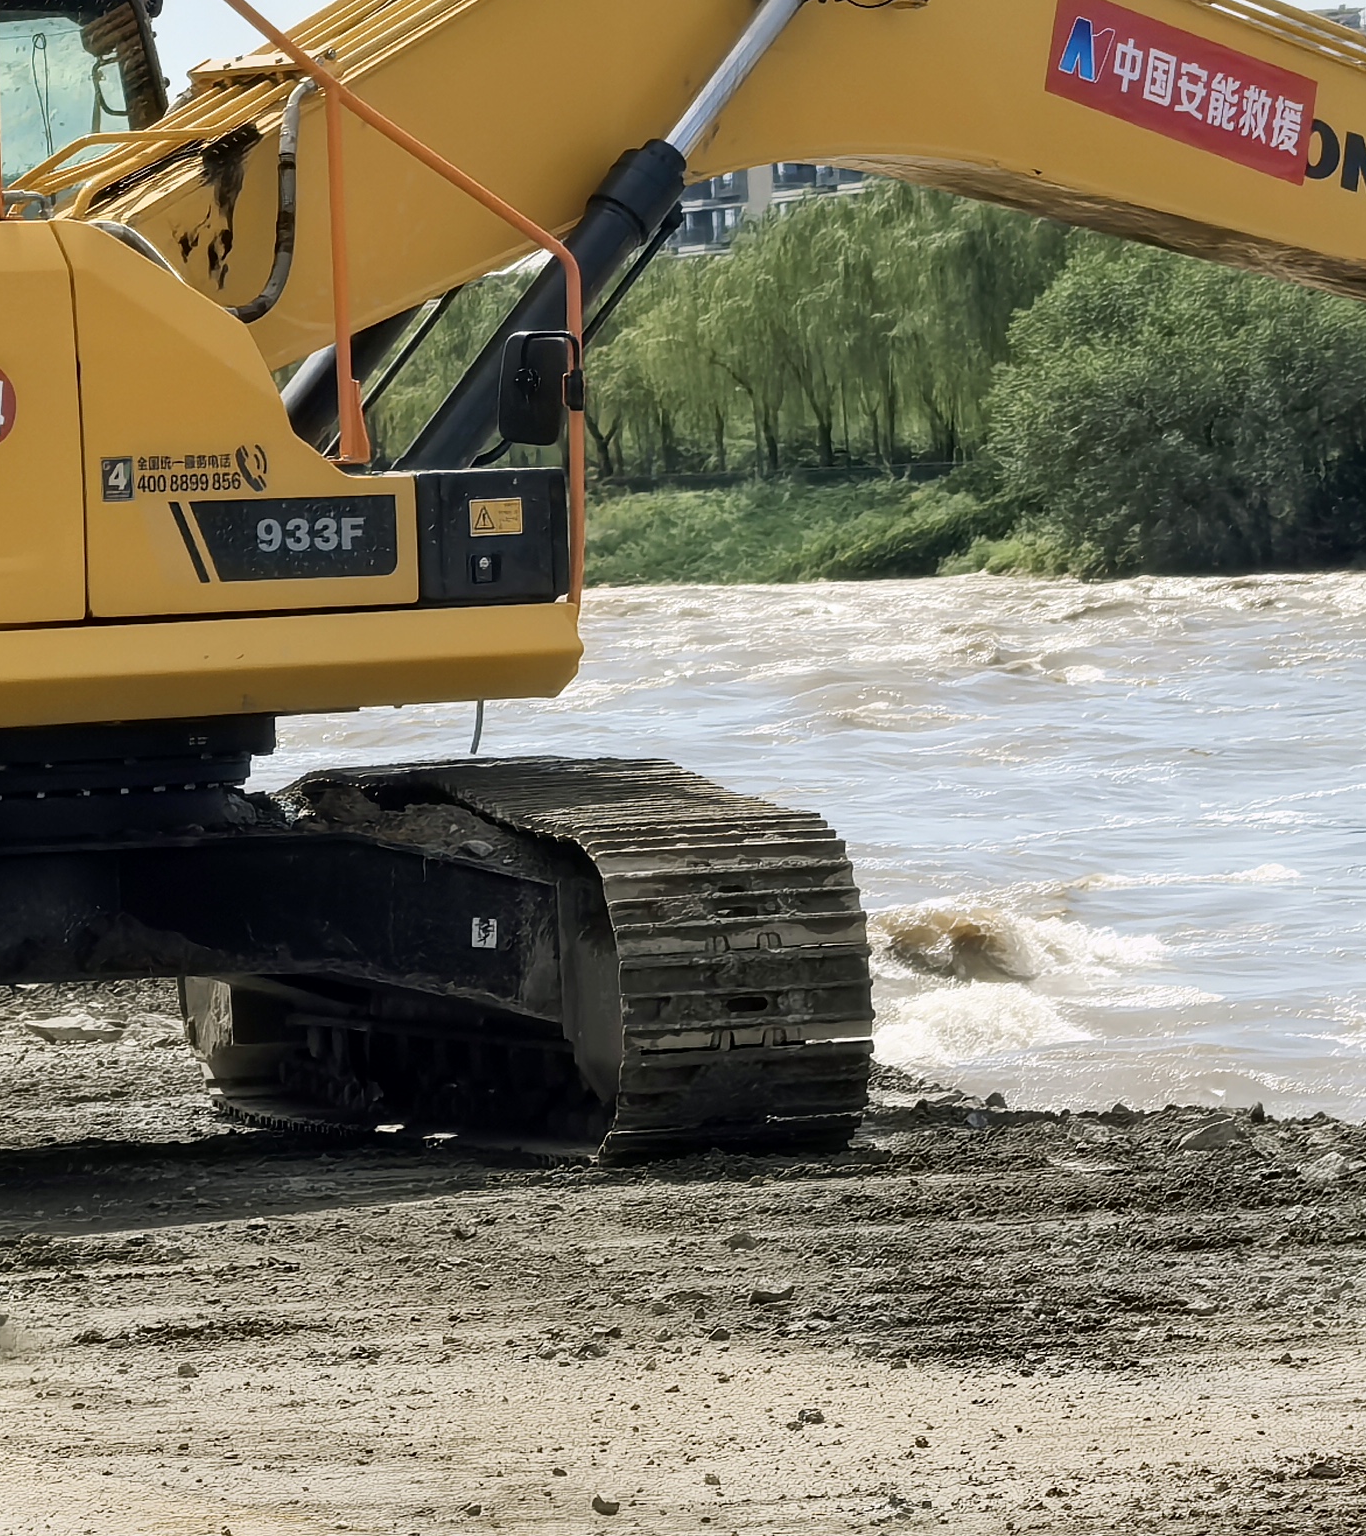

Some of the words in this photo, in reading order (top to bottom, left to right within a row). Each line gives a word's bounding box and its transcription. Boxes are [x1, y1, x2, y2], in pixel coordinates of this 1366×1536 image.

[1112, 37, 1305, 158] 中国安能救援
[137, 474, 167, 493] 400
[170, 473, 209, 492] 8899
[212, 471, 241, 491] 856
[255, 516, 366, 553] 933F
